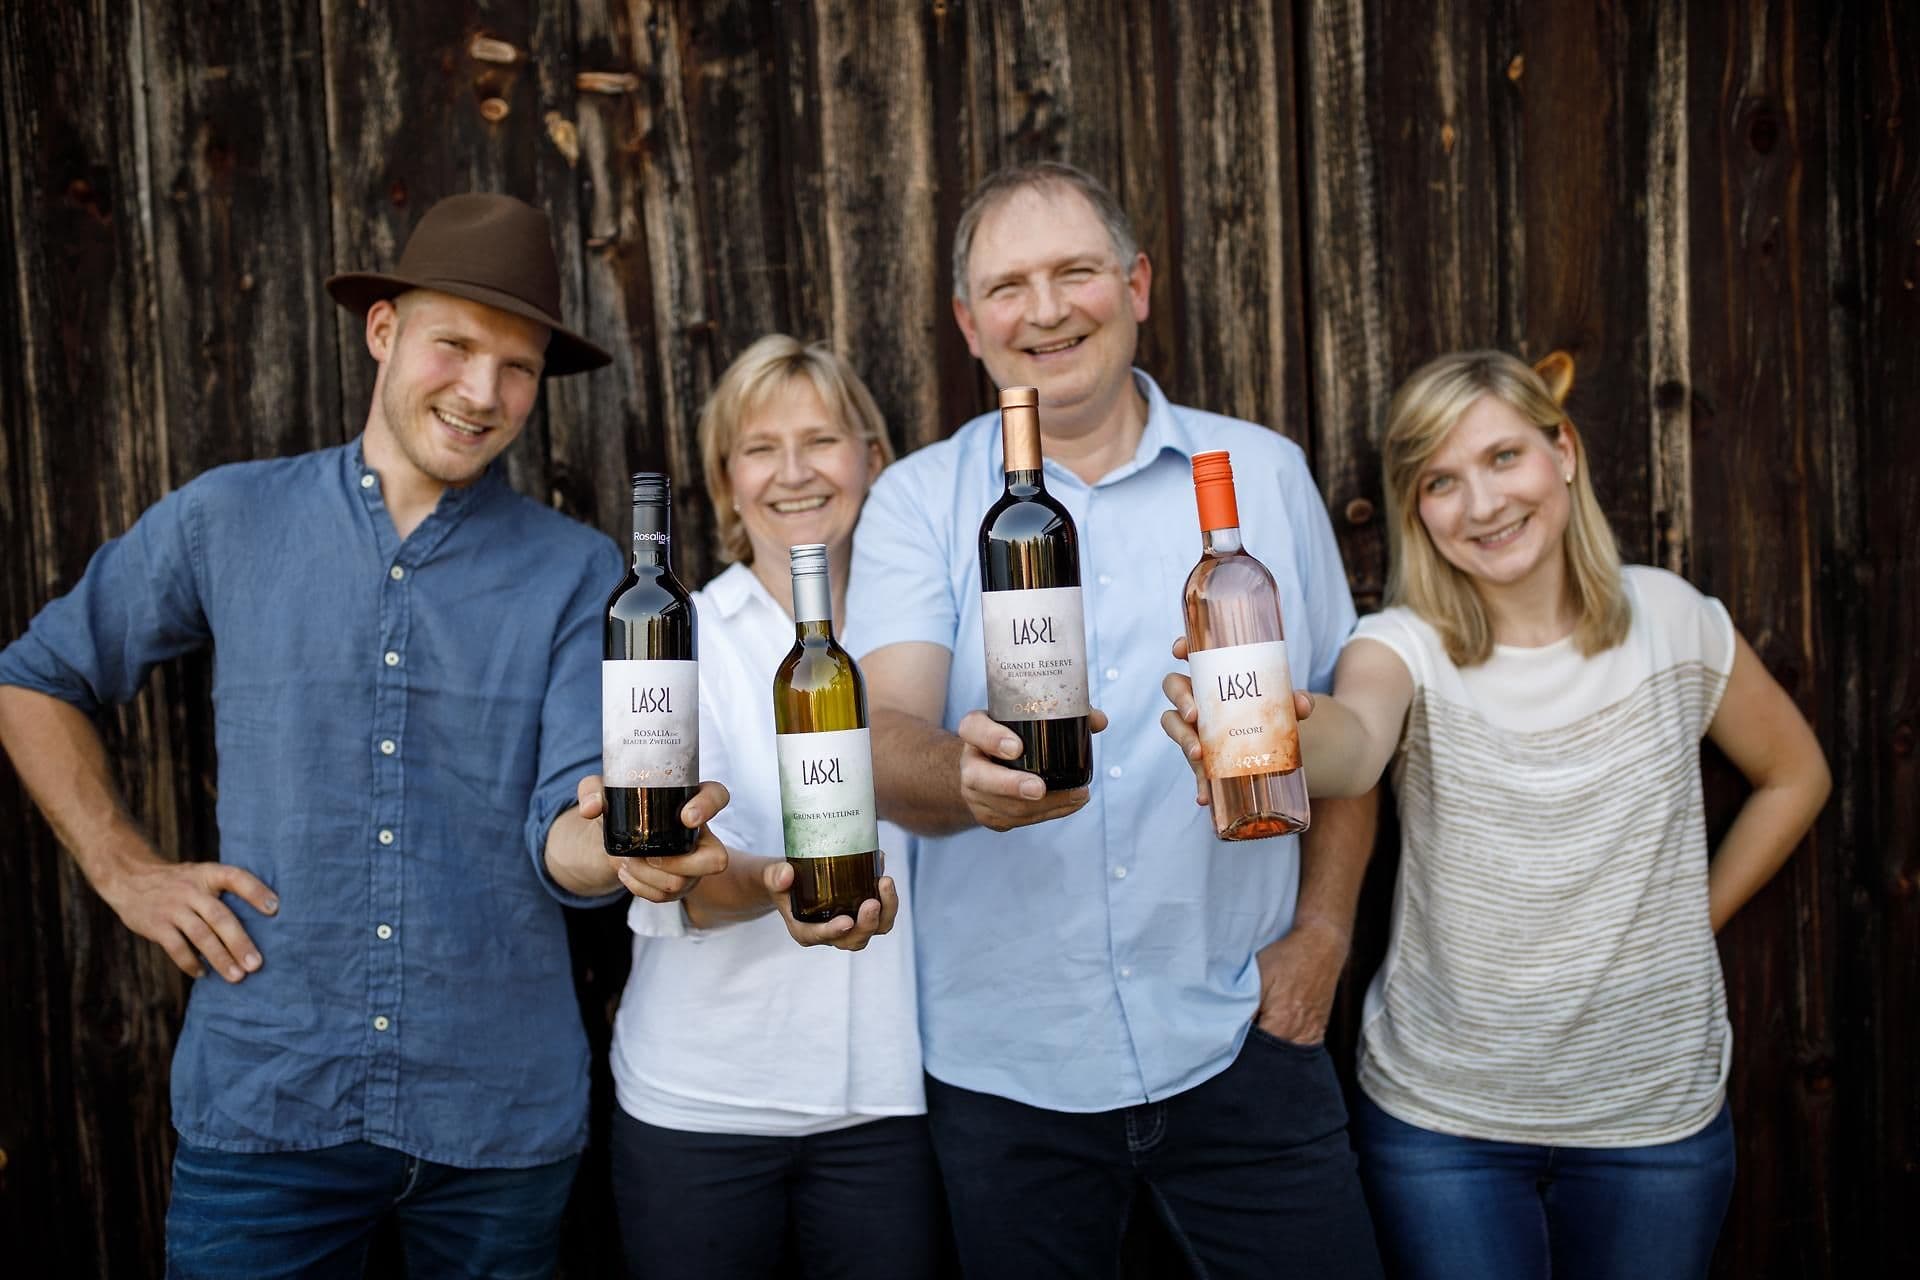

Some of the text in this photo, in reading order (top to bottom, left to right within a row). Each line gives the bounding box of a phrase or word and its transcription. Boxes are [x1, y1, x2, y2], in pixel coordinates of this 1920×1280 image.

[634, 531, 666, 541] Rosalia
[1038, 658, 1073, 668] RESERVE
[1229, 726, 1264, 737] COLORE
